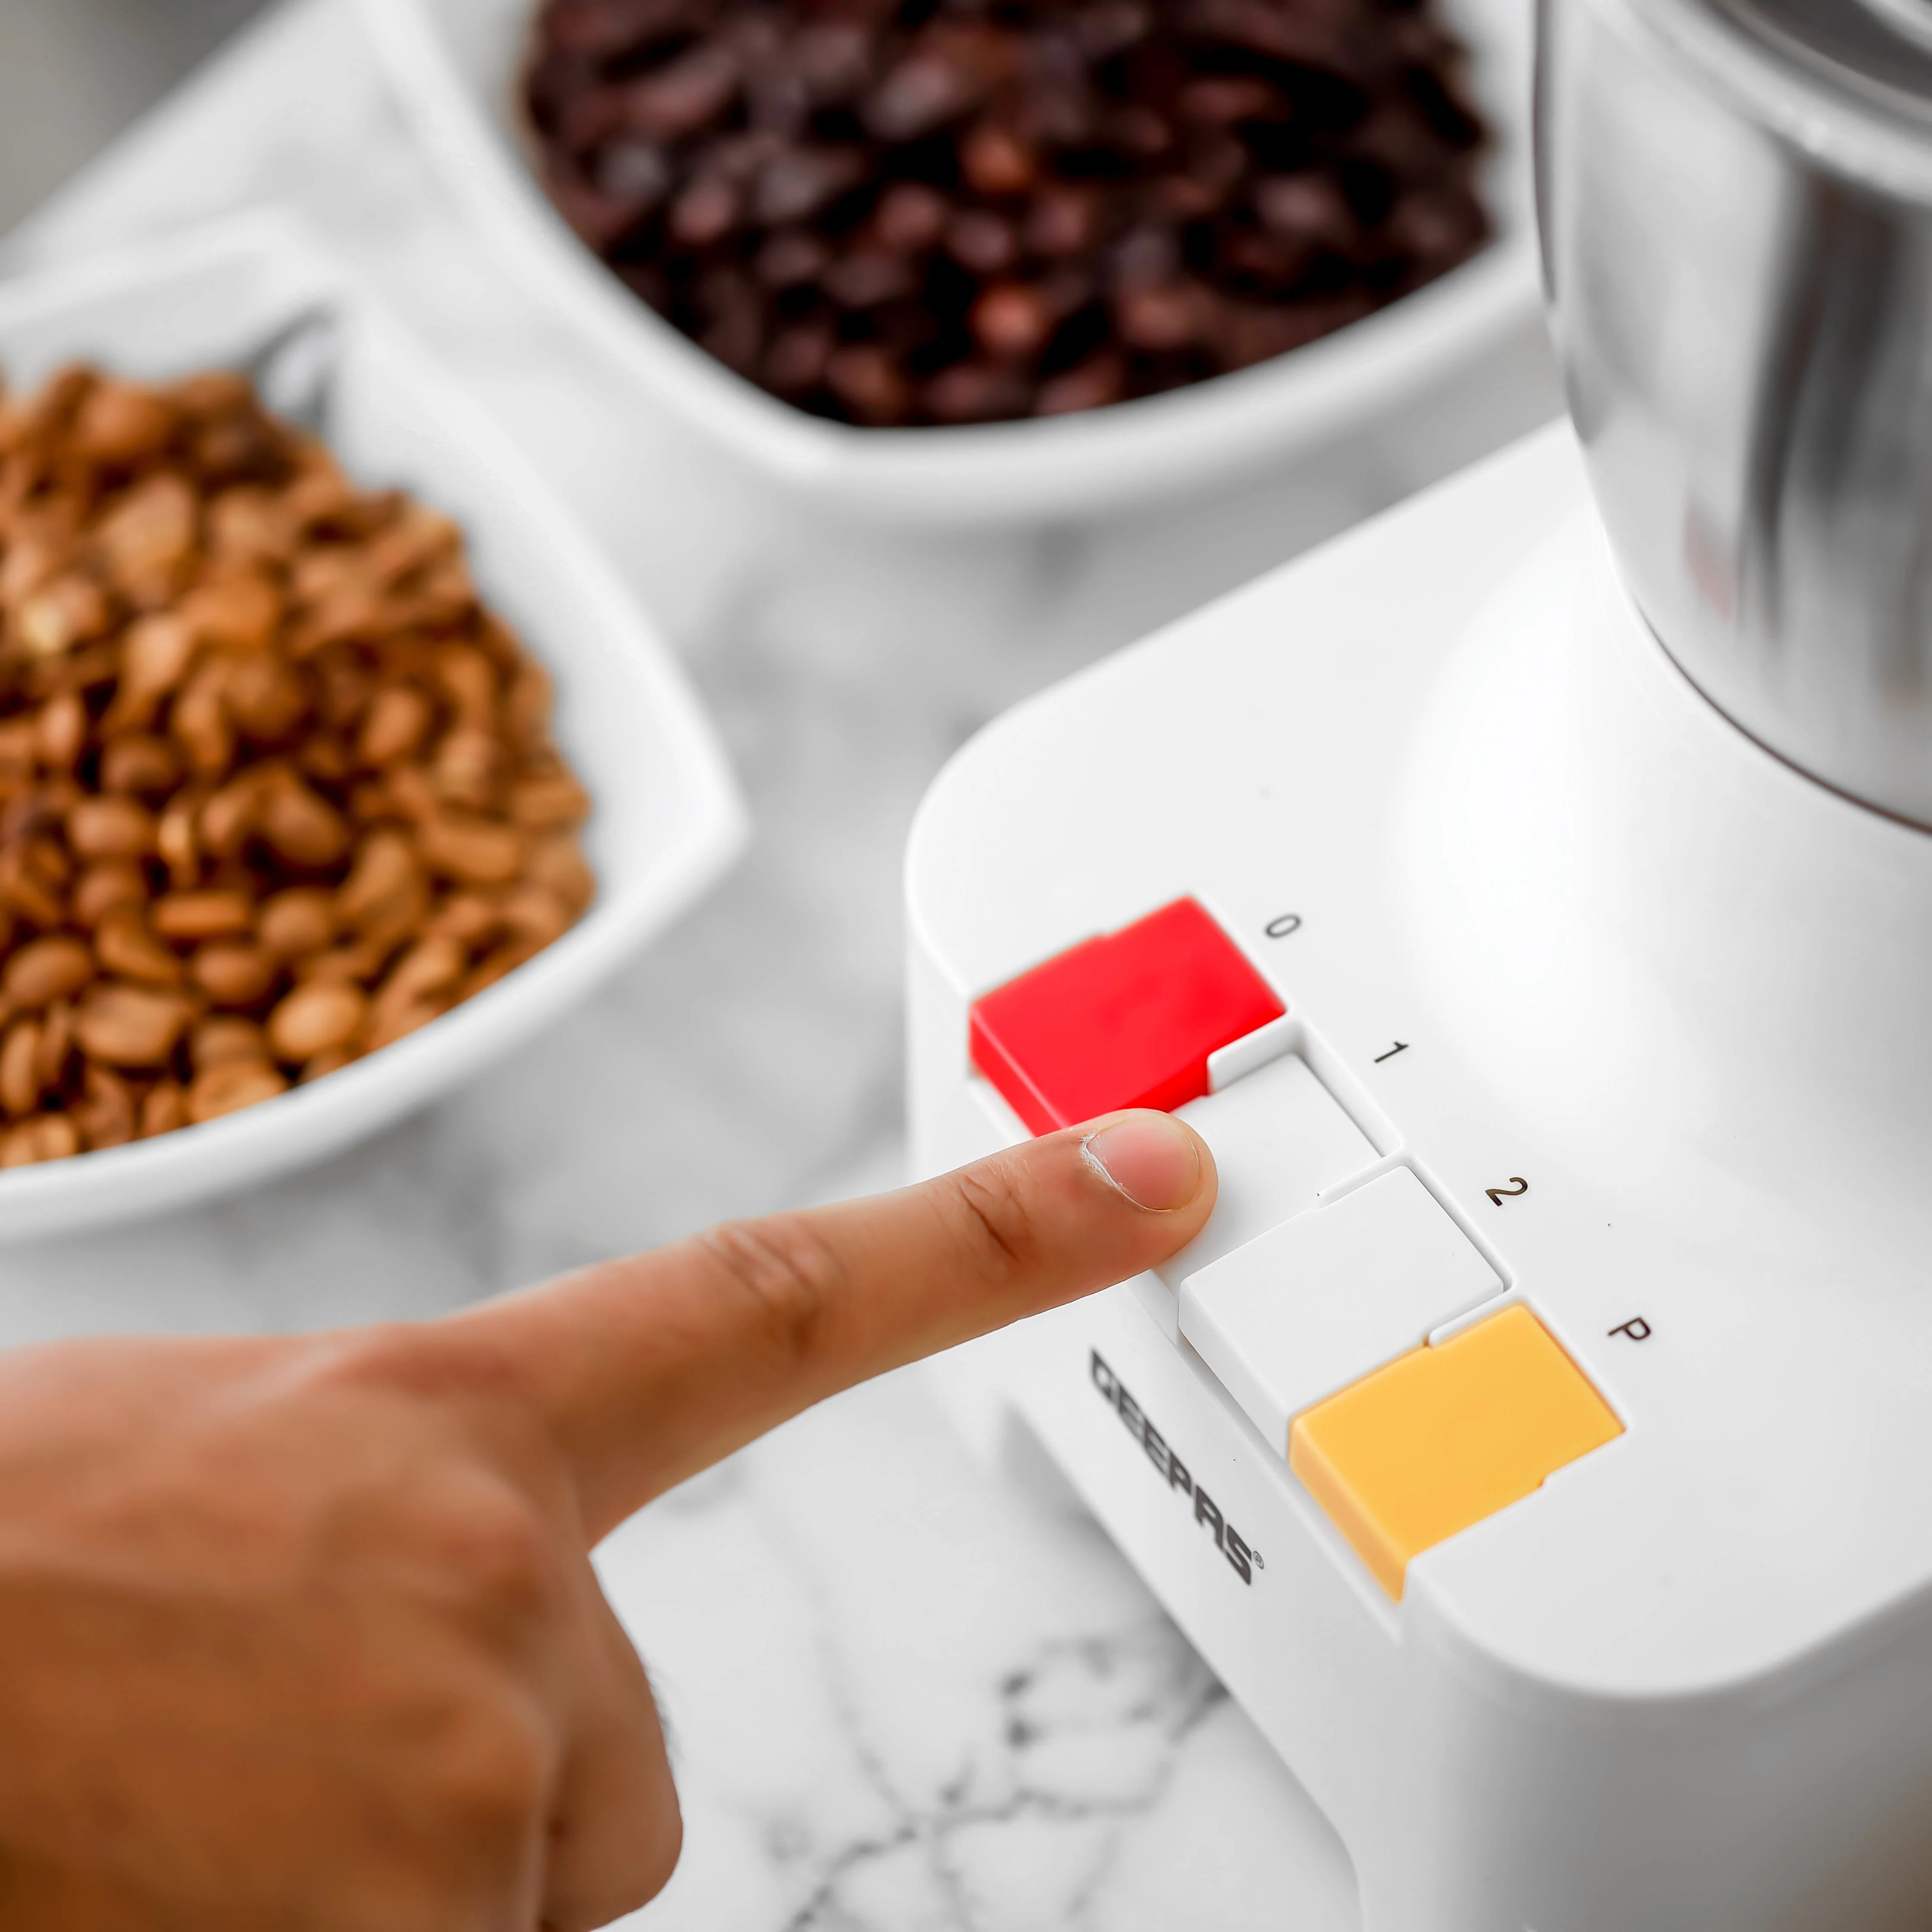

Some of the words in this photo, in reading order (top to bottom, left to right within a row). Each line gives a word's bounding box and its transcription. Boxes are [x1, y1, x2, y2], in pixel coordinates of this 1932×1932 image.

[1264, 914, 1302, 938] 0
[1374, 1041, 1409, 1064] 1
[1484, 1176, 1528, 1207] 2
[1606, 1315, 1652, 1342] P
